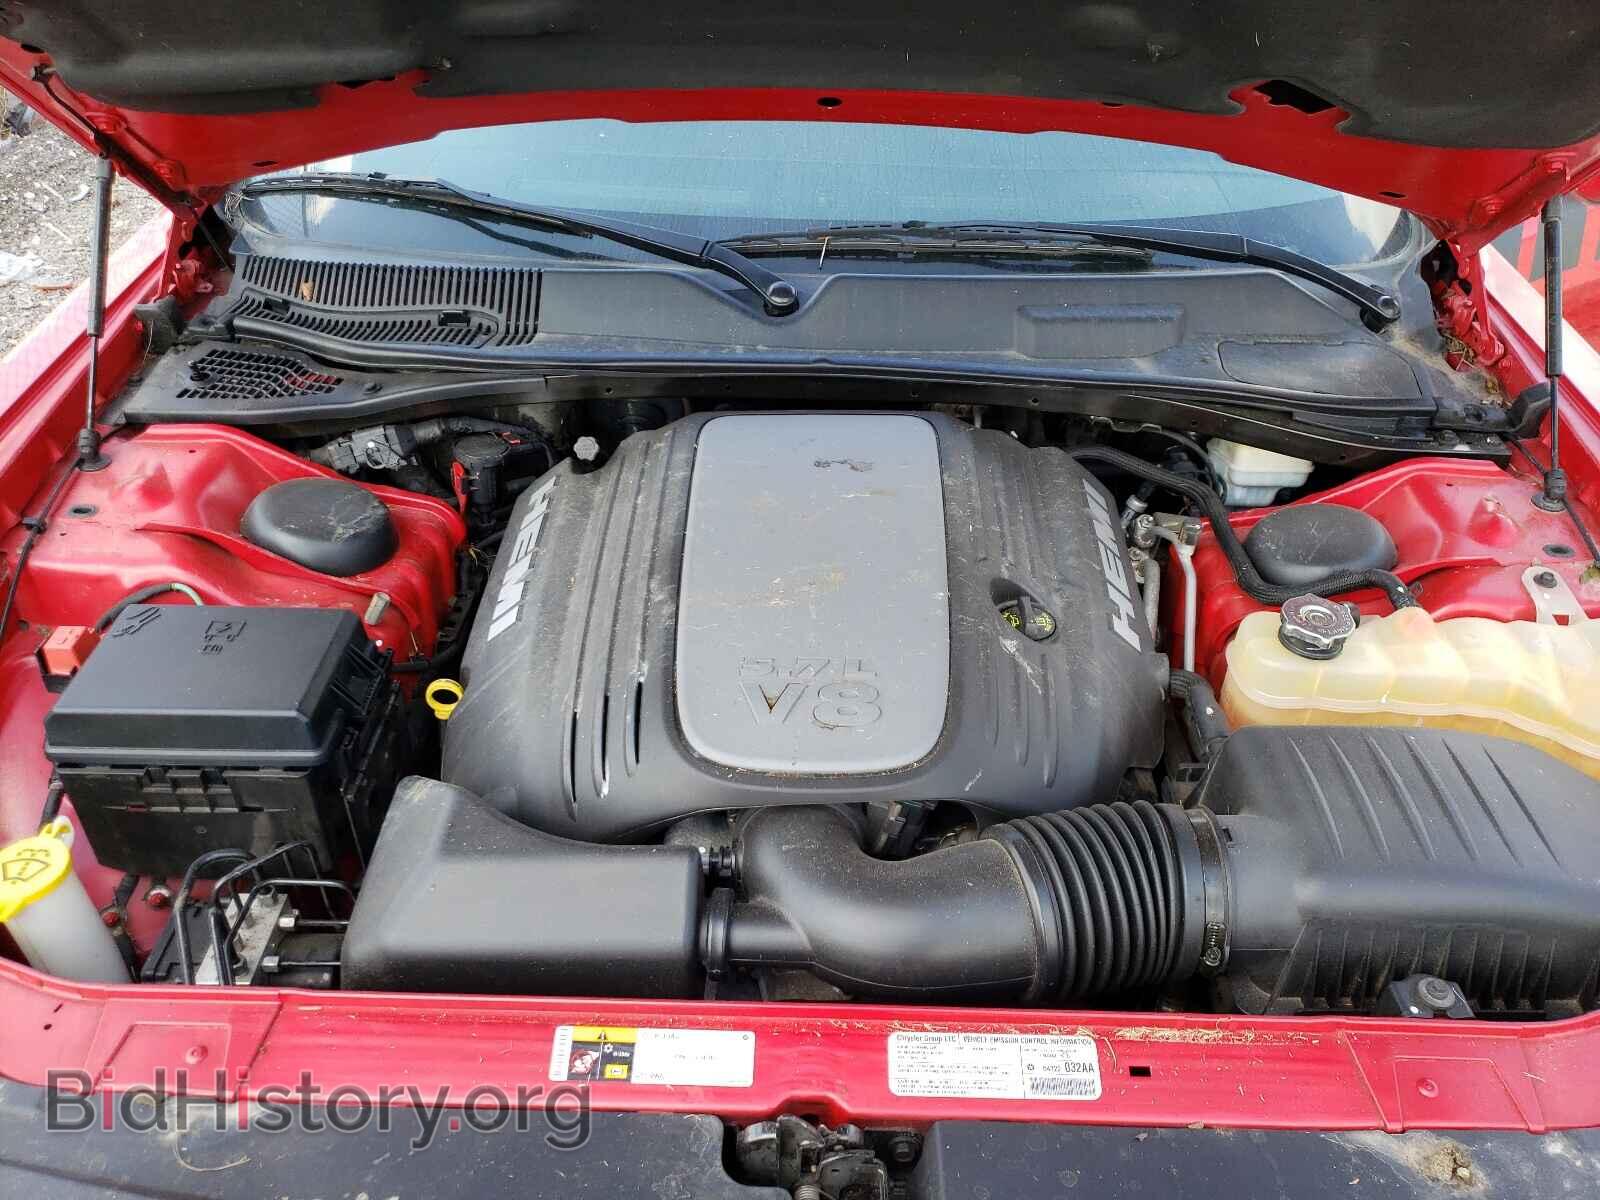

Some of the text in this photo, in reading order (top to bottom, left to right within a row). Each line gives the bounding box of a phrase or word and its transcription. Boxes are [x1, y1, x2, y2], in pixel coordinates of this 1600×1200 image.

[487, 475, 557, 642] HEMI
[1082, 478, 1142, 653] HEMI
[737, 655, 879, 678] 5.7L
[738, 681, 883, 729] V8
[896, 1034, 922, 1043] Chrysler
[924, 1034, 943, 1043] Group
[990, 1036, 1019, 1044] EMISSION
[1020, 1037, 1048, 1045] CONTROL
